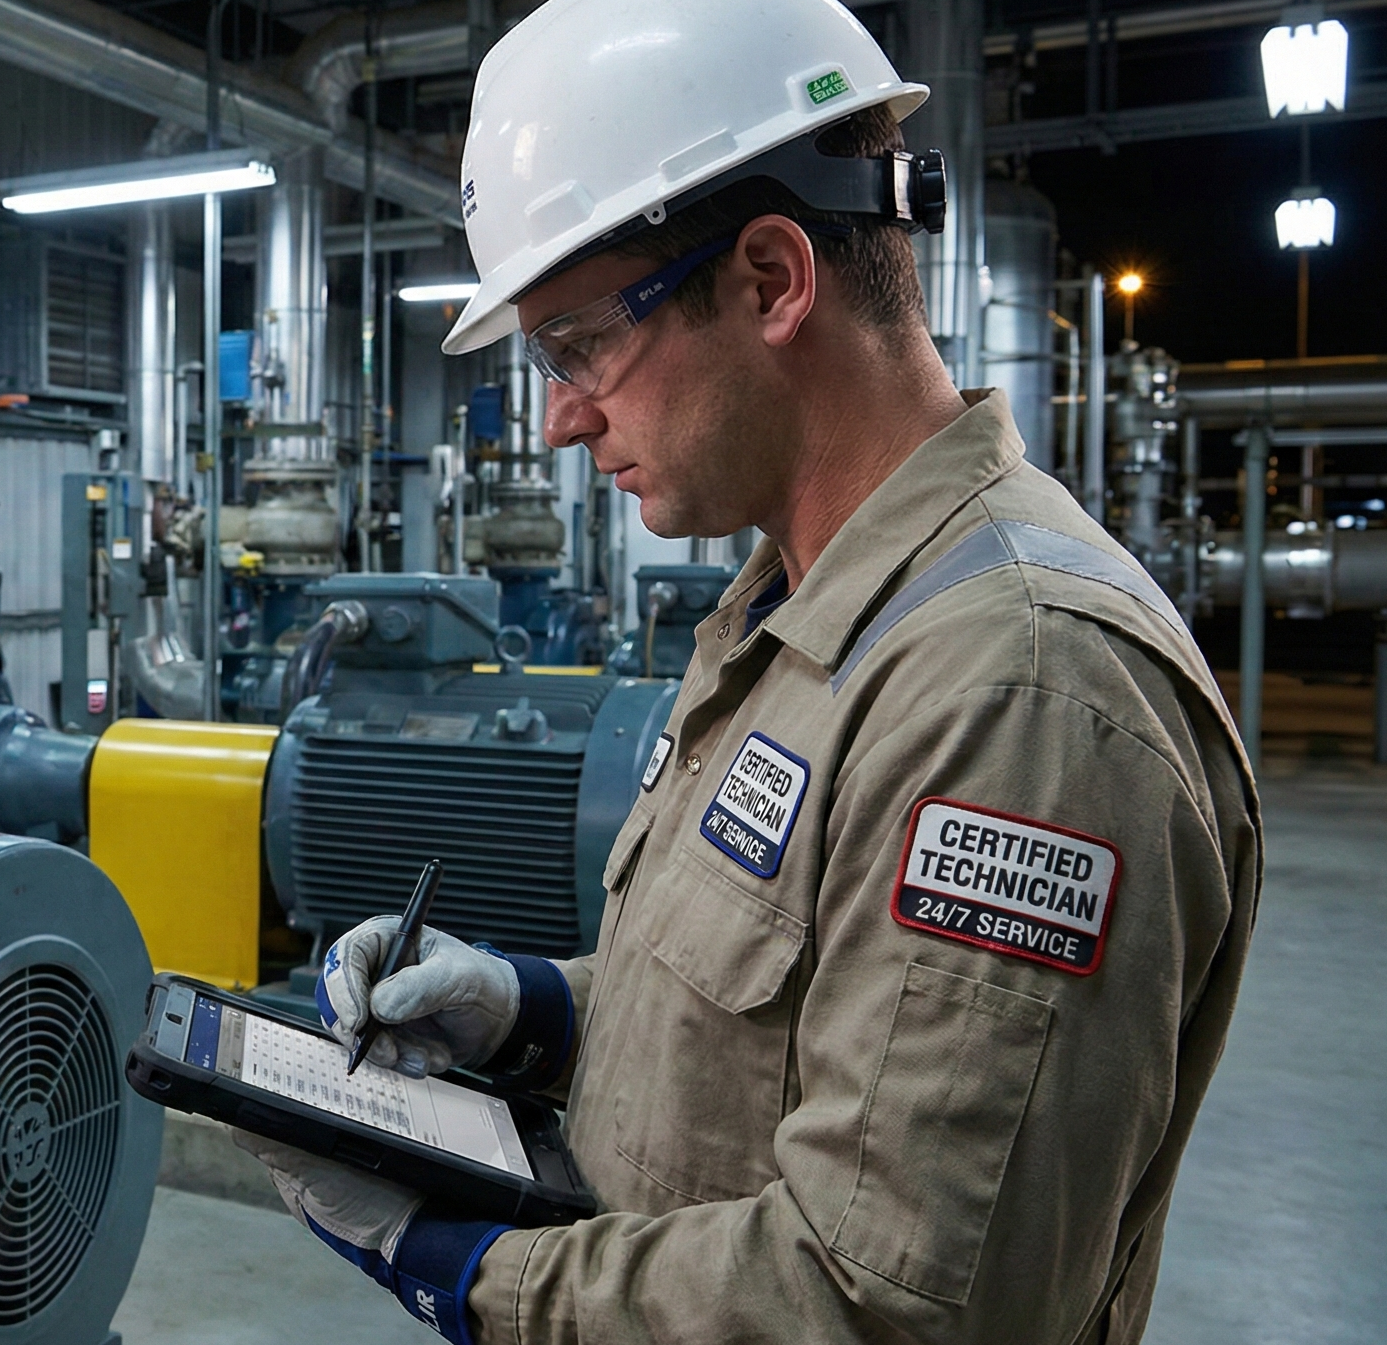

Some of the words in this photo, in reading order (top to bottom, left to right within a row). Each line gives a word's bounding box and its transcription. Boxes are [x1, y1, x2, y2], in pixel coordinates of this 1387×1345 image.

[739, 749, 793, 798] CERTIFIED
[723, 774, 787, 833] TECHNICIAN
[722, 820, 767, 865] SERVICE
[939, 819, 1094, 882] CERTIFIED
[920, 849, 1099, 922] TECHNICIAN
[916, 897, 971, 928] 24/7
[976, 912, 1080, 960] SERVICE
[416, 1289, 442, 1333] LIR
